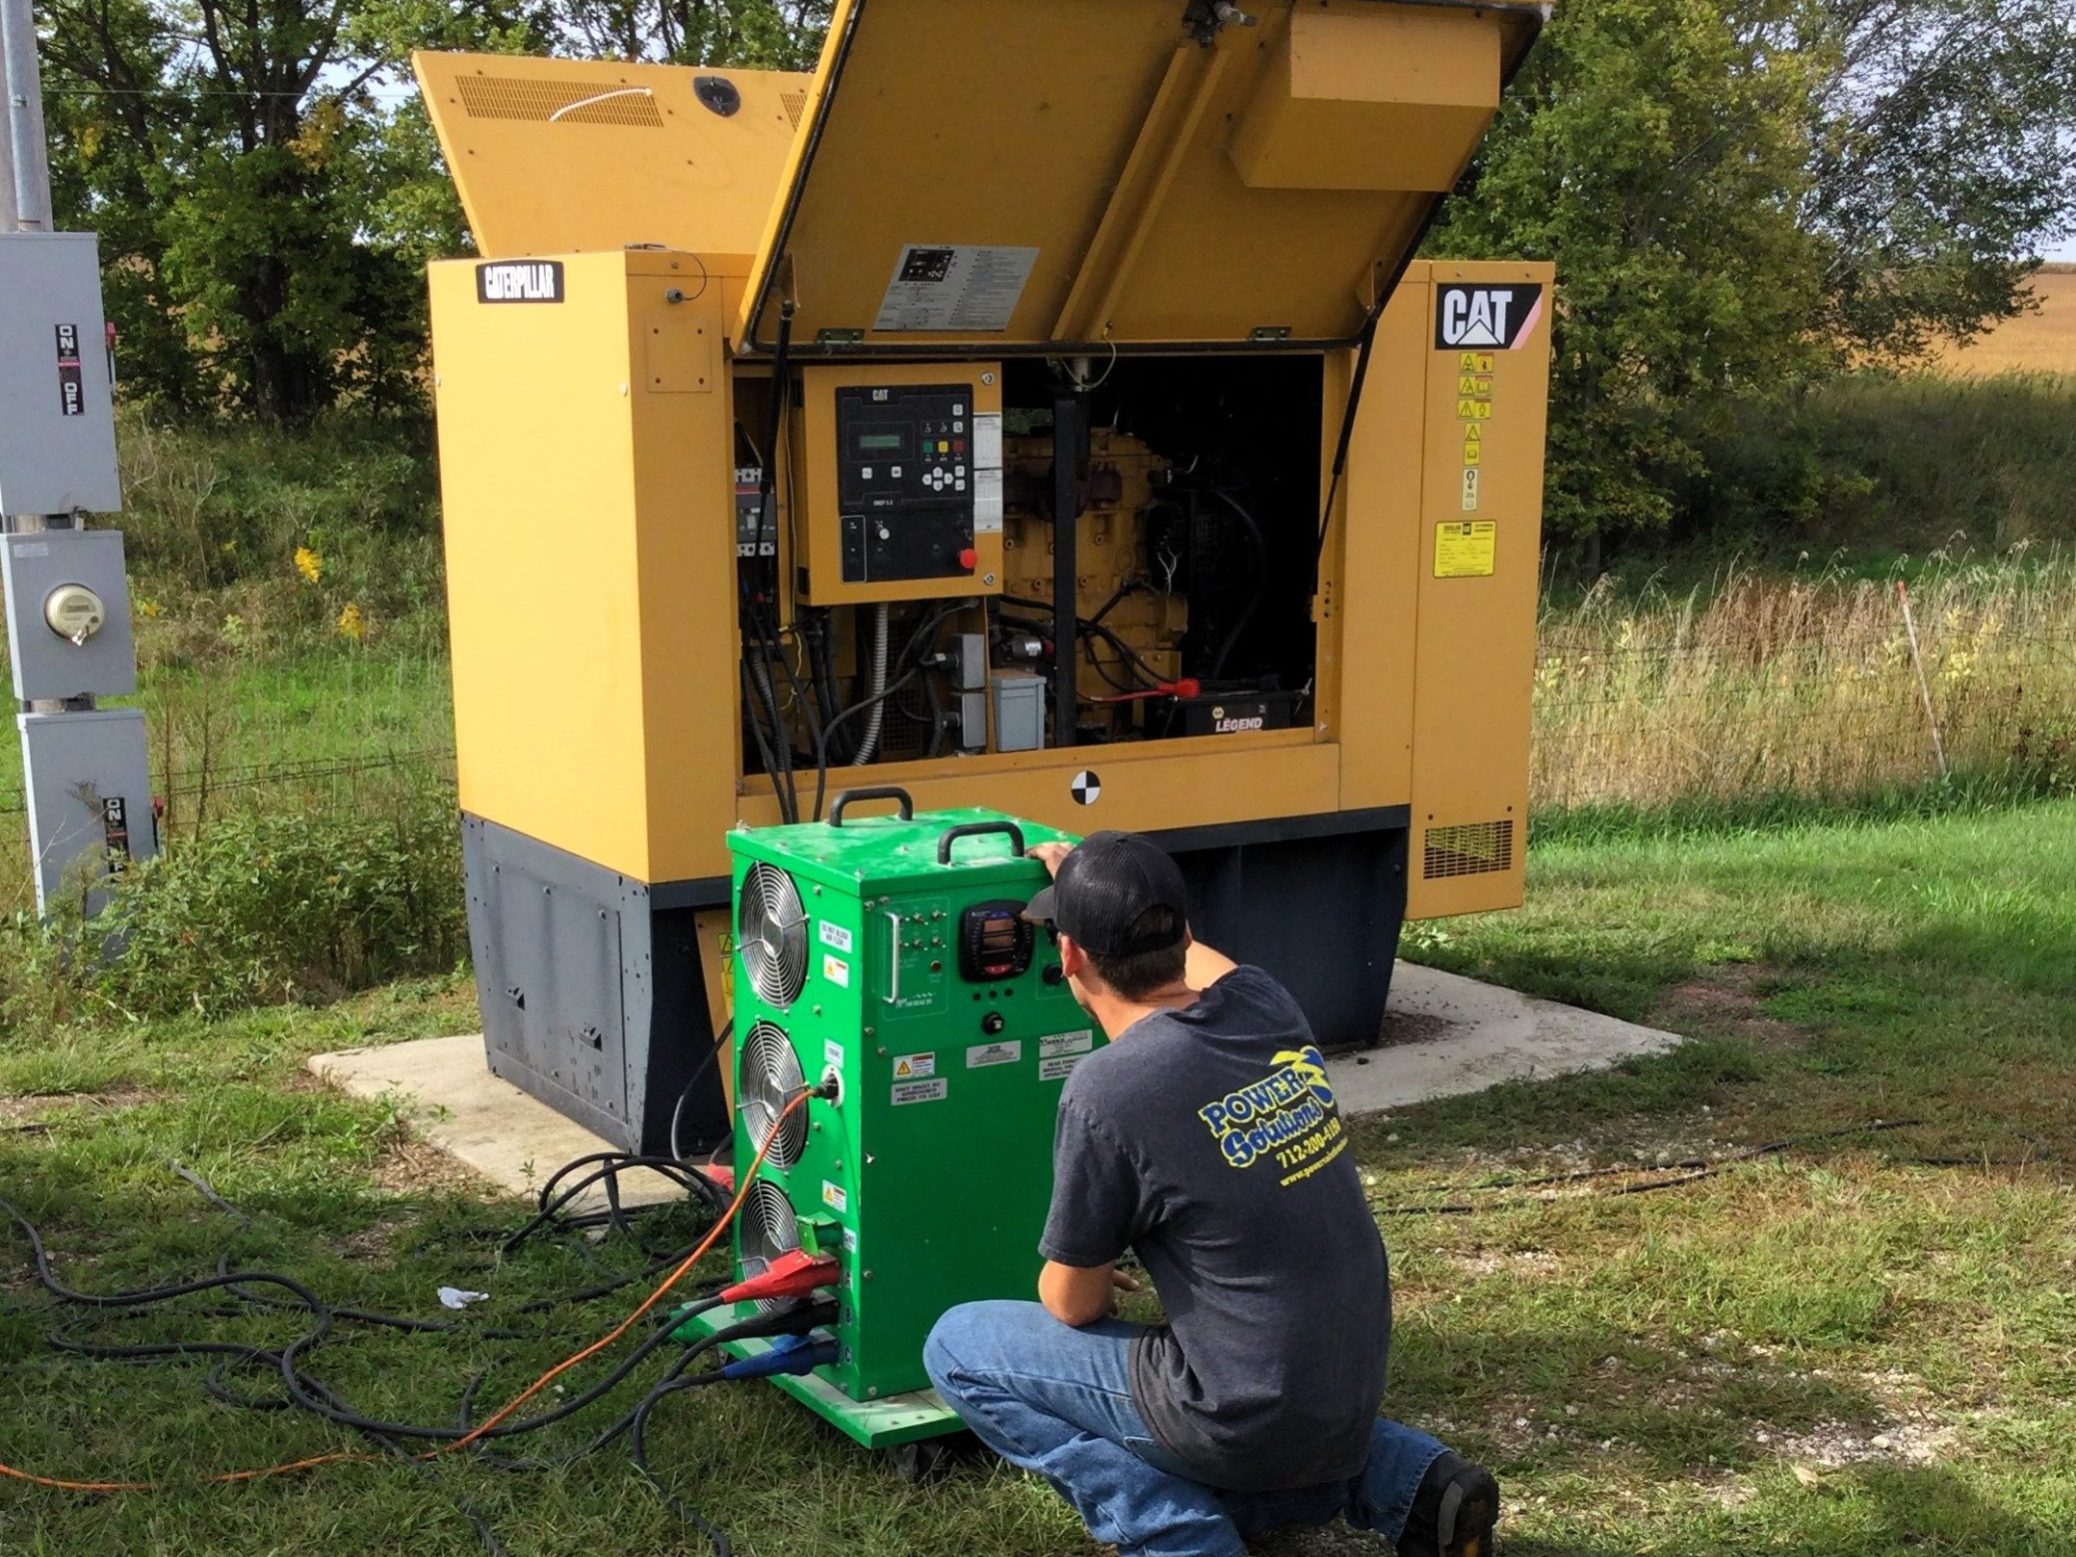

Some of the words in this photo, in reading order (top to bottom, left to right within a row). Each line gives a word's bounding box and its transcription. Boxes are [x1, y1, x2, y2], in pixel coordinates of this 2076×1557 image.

[485, 264, 555, 299] CATERPILLAR
[1443, 289, 1513, 345] CAT
[60, 325, 75, 349] ON
[64, 382, 78, 415] OFF
[872, 389, 889, 401] CAT
[1215, 717, 1263, 732] LEGEND
[107, 799, 122, 821] ON
[1198, 1066, 1307, 1139] POWER
[1221, 1096, 1324, 1168] Solutions
